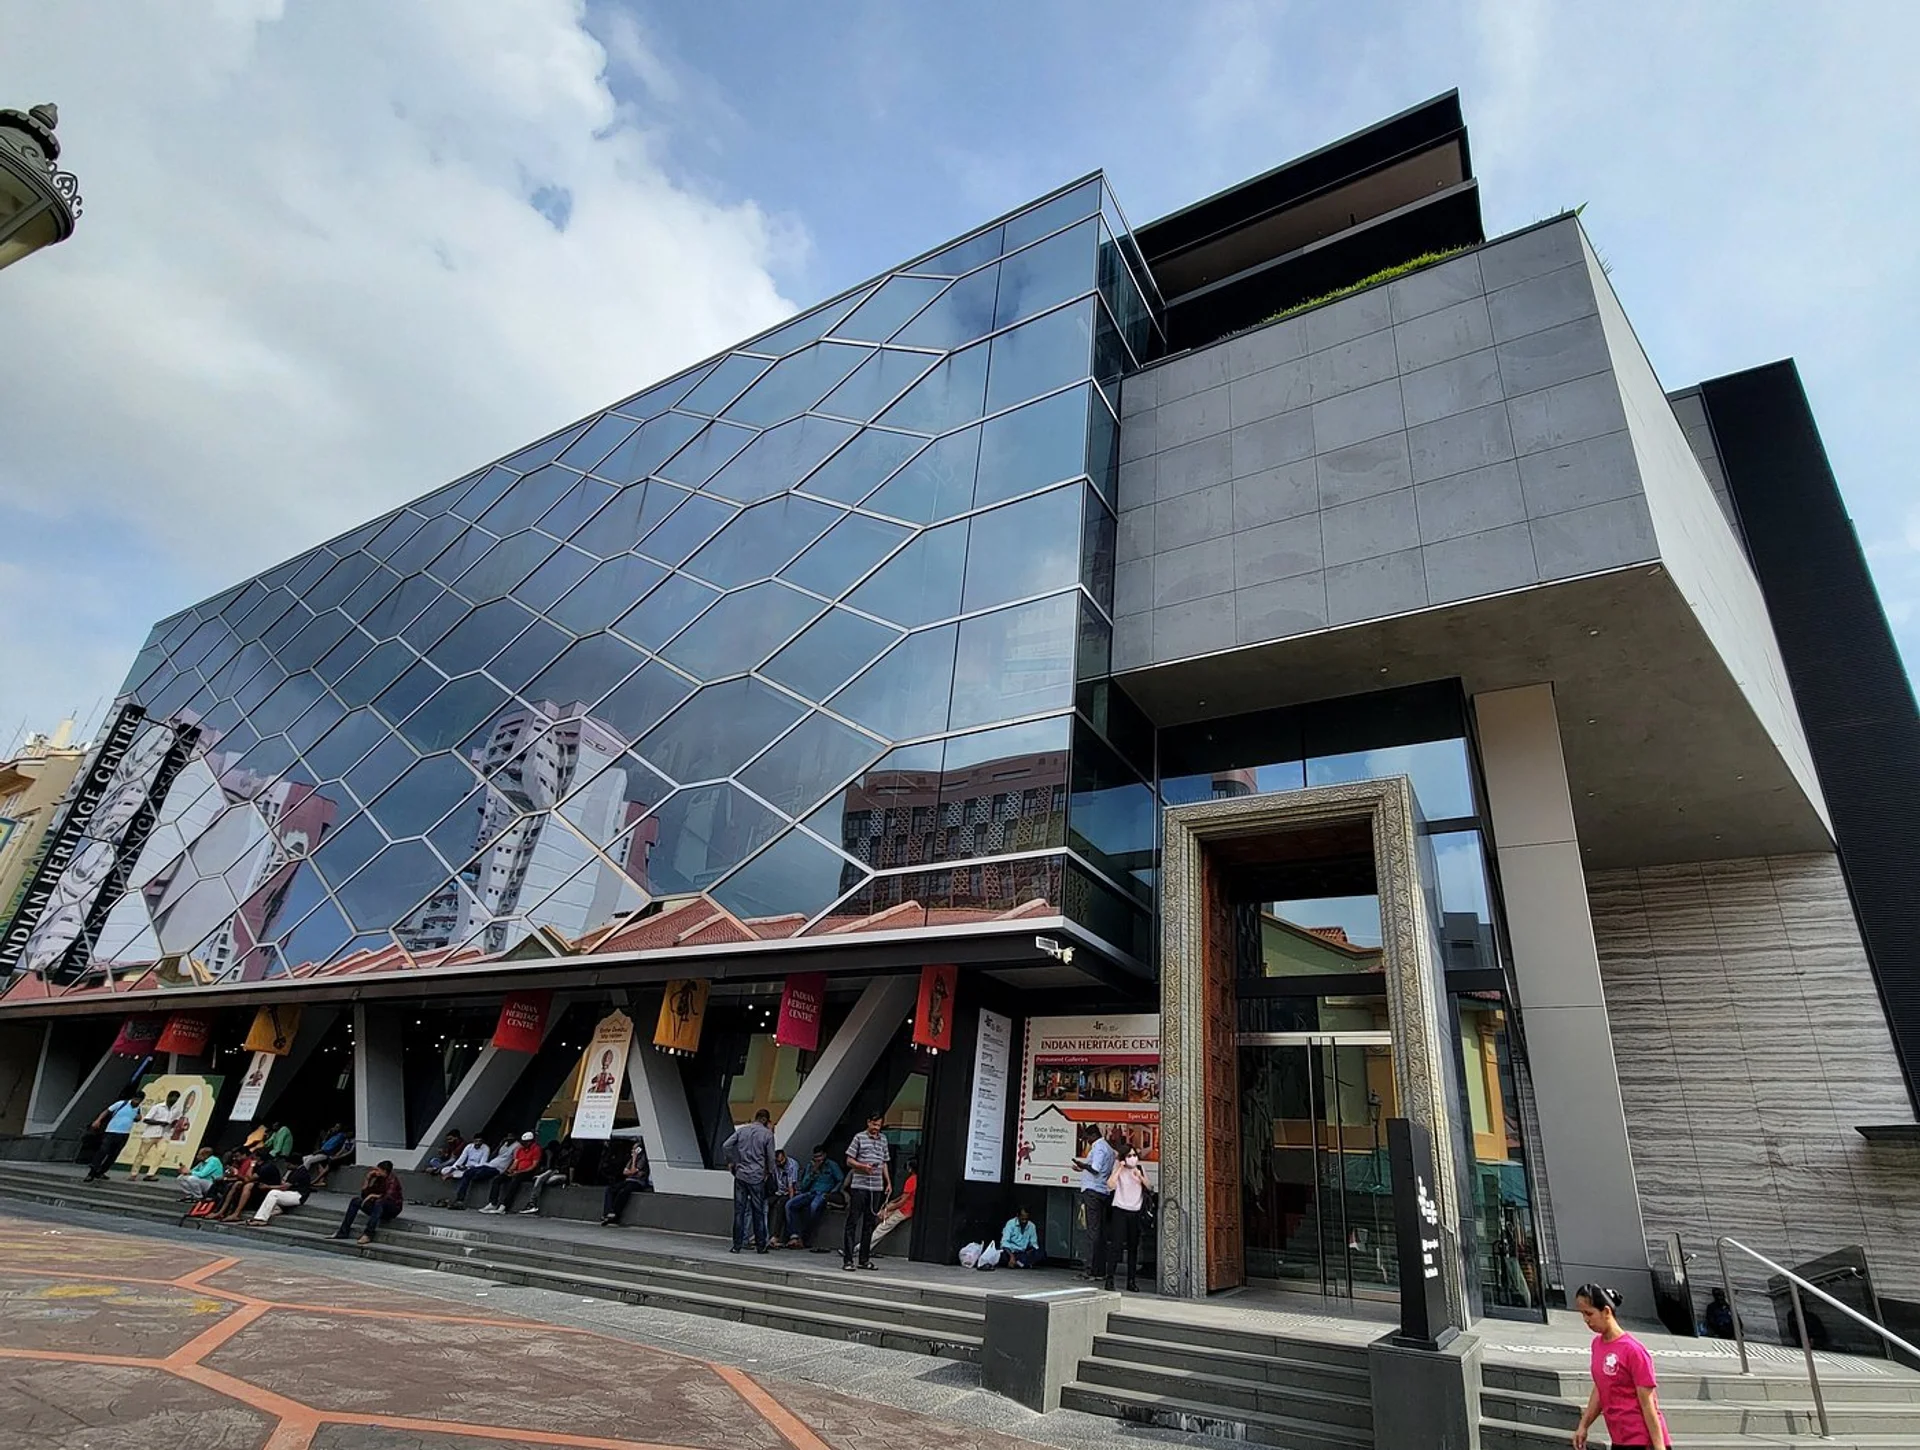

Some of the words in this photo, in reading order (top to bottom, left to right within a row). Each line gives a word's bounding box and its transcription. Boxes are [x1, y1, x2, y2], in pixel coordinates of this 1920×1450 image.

[1, 898, 48, 966] INDIAN
[43, 789, 102, 888] HERITAGE
[94, 710, 143, 786] CENTRE
[792, 990, 815, 1002] INDIAN
[512, 1002, 538, 1013] INDIAN
[787, 999, 819, 1013] HERITAGE
[505, 1009, 539, 1022] HERITAGE
[788, 1009, 814, 1022] CENTRE
[507, 1018, 534, 1029] CENTRE
[1041, 1039, 1077, 1050] INDIAN
[1078, 1039, 1129, 1049] HERITAGE
[1128, 1112, 1149, 1120] Special
